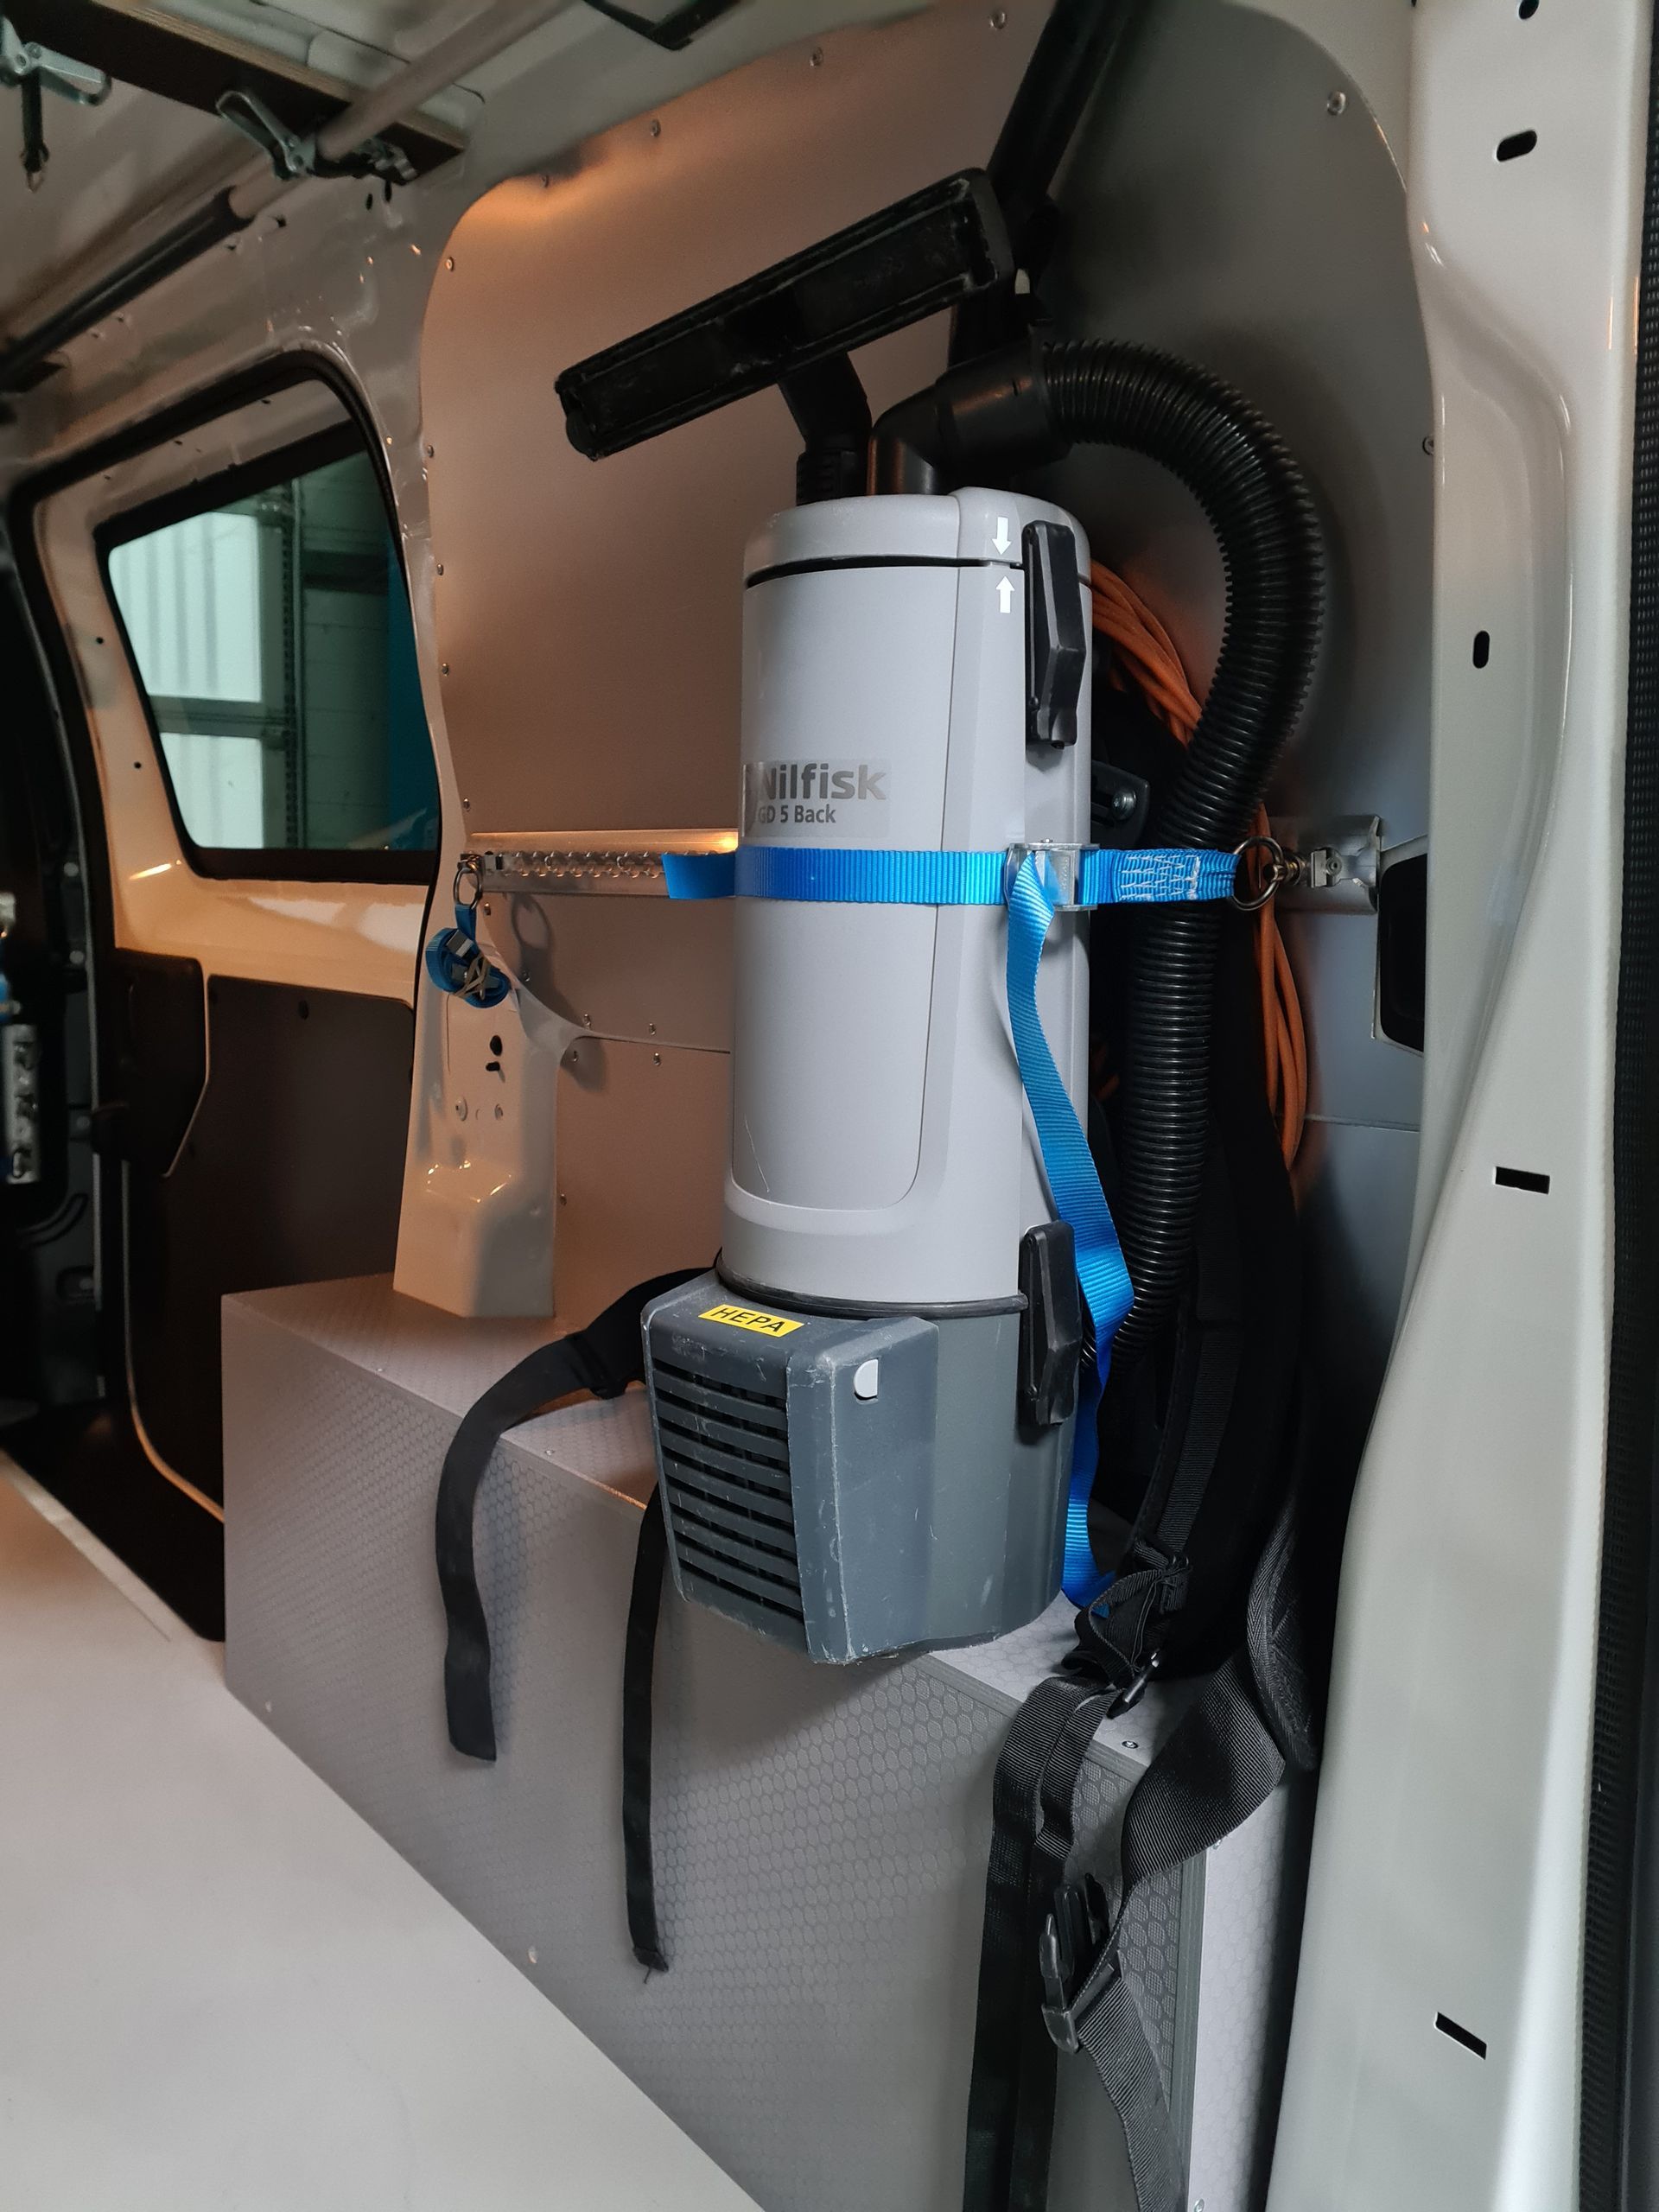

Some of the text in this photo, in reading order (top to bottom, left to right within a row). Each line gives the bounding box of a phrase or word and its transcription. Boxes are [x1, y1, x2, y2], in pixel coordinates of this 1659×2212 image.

[759, 763, 887, 800] Nilfisk
[758, 804, 836, 823] GD 5 Back
[710, 1307, 785, 1333] HEPA
